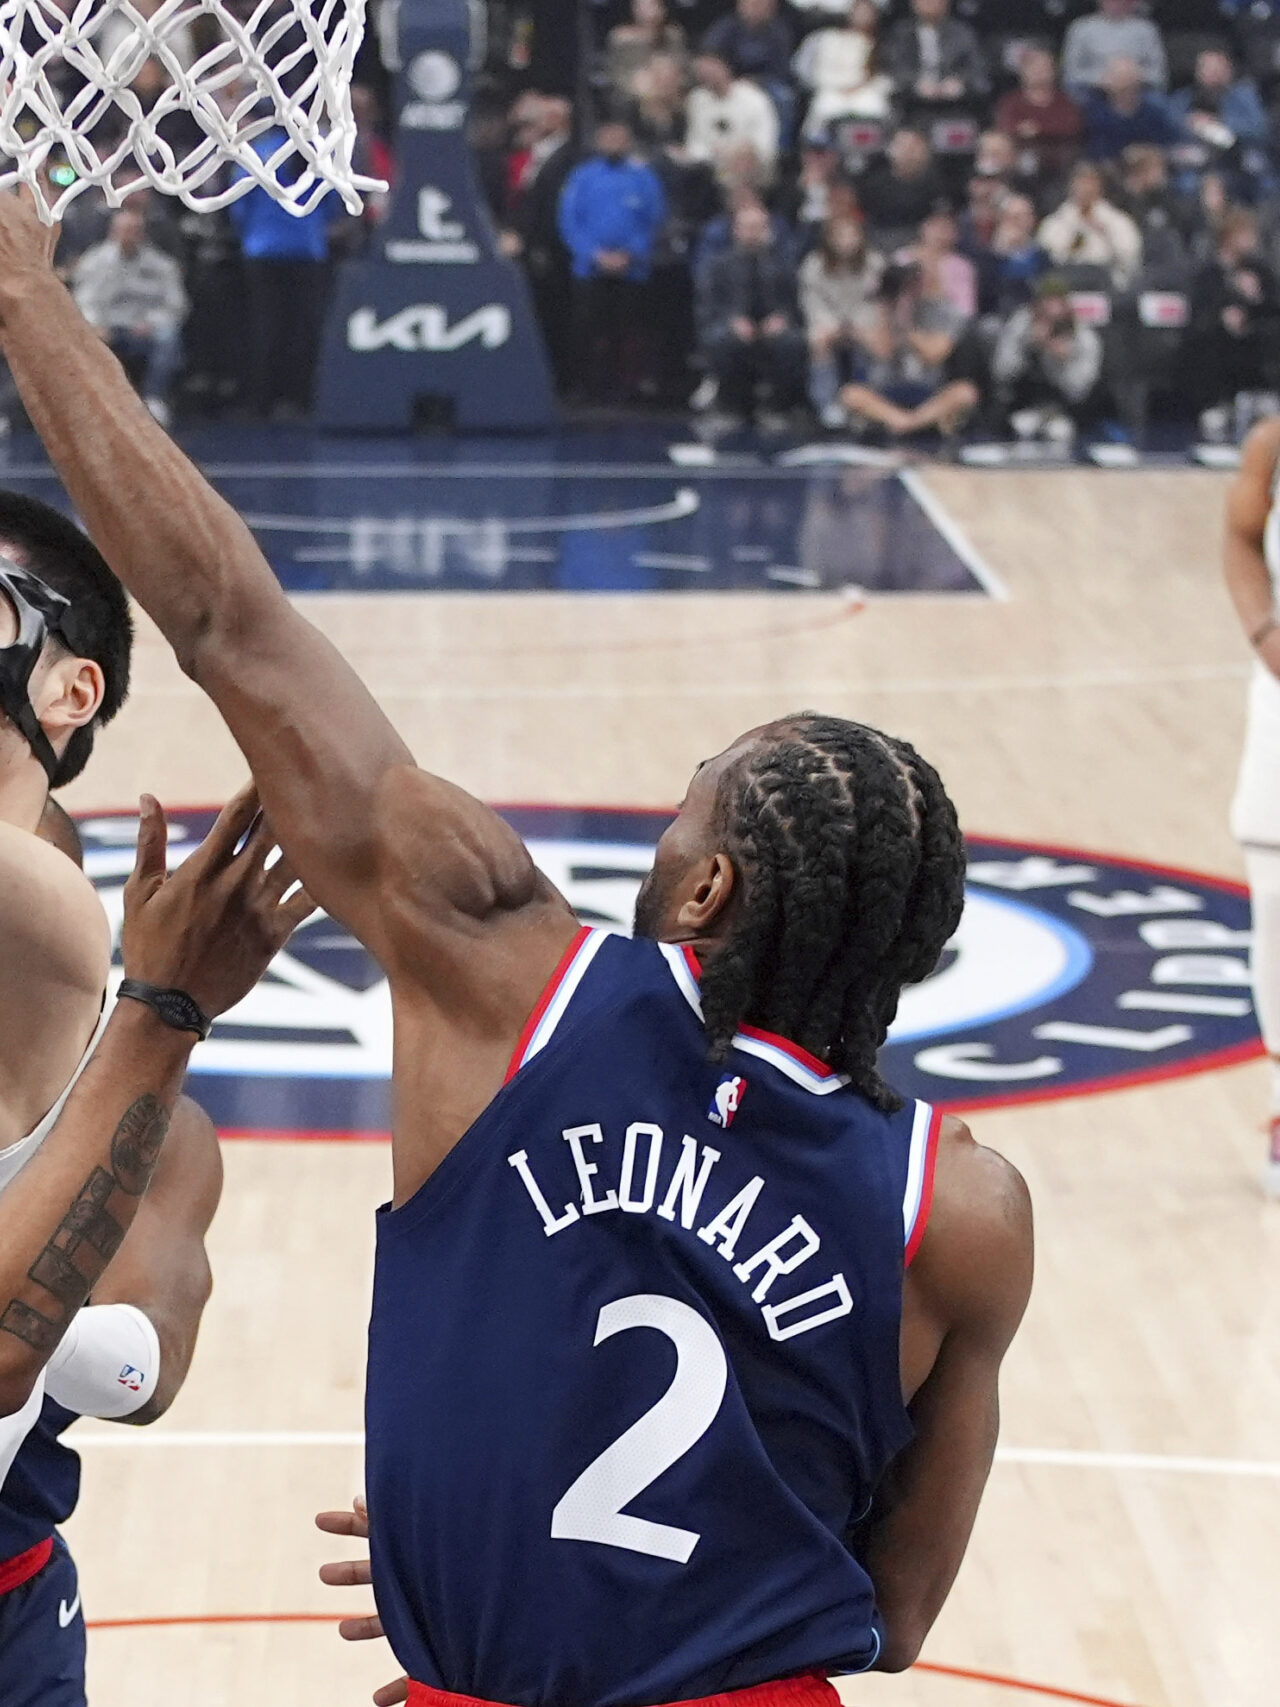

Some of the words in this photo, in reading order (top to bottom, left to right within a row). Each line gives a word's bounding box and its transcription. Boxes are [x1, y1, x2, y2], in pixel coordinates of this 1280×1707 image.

[913, 856, 1254, 1082] CLIPPER
[507, 1121, 854, 1342] LEONARD
[550, 1294, 728, 1564] 2
